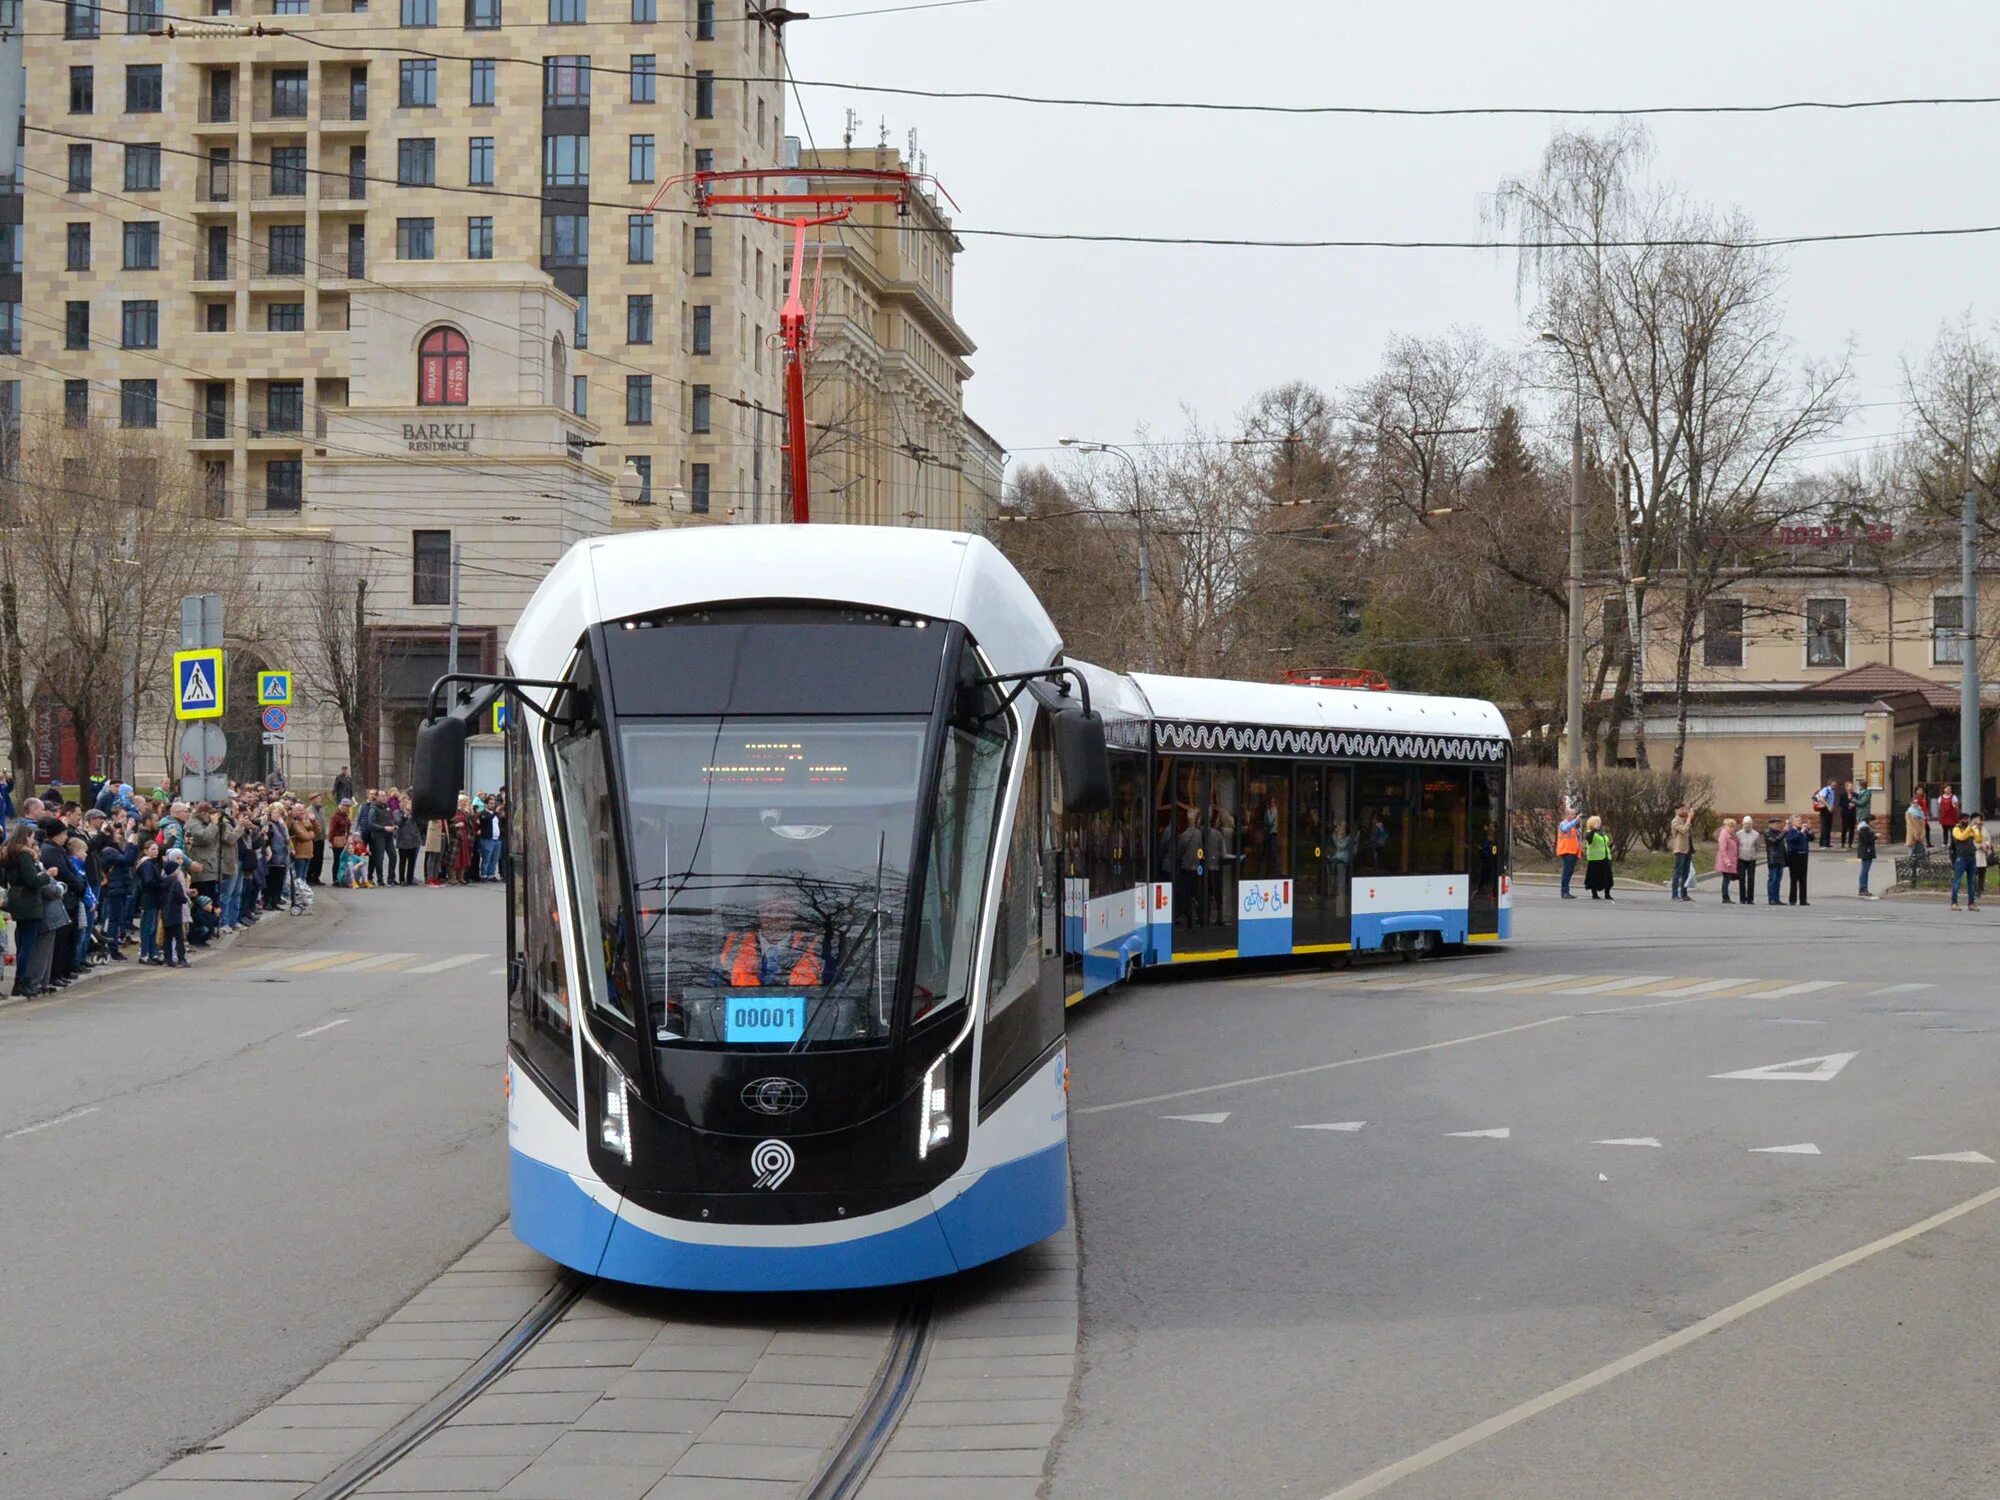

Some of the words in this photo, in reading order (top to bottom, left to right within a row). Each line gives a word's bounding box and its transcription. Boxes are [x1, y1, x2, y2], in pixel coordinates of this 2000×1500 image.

[428, 360, 437, 398] ПРОДАЖА
[402, 423, 476, 440] BARKLI
[408, 441, 470, 451] RESIDENCE
[735, 1008, 795, 1028] 00001
